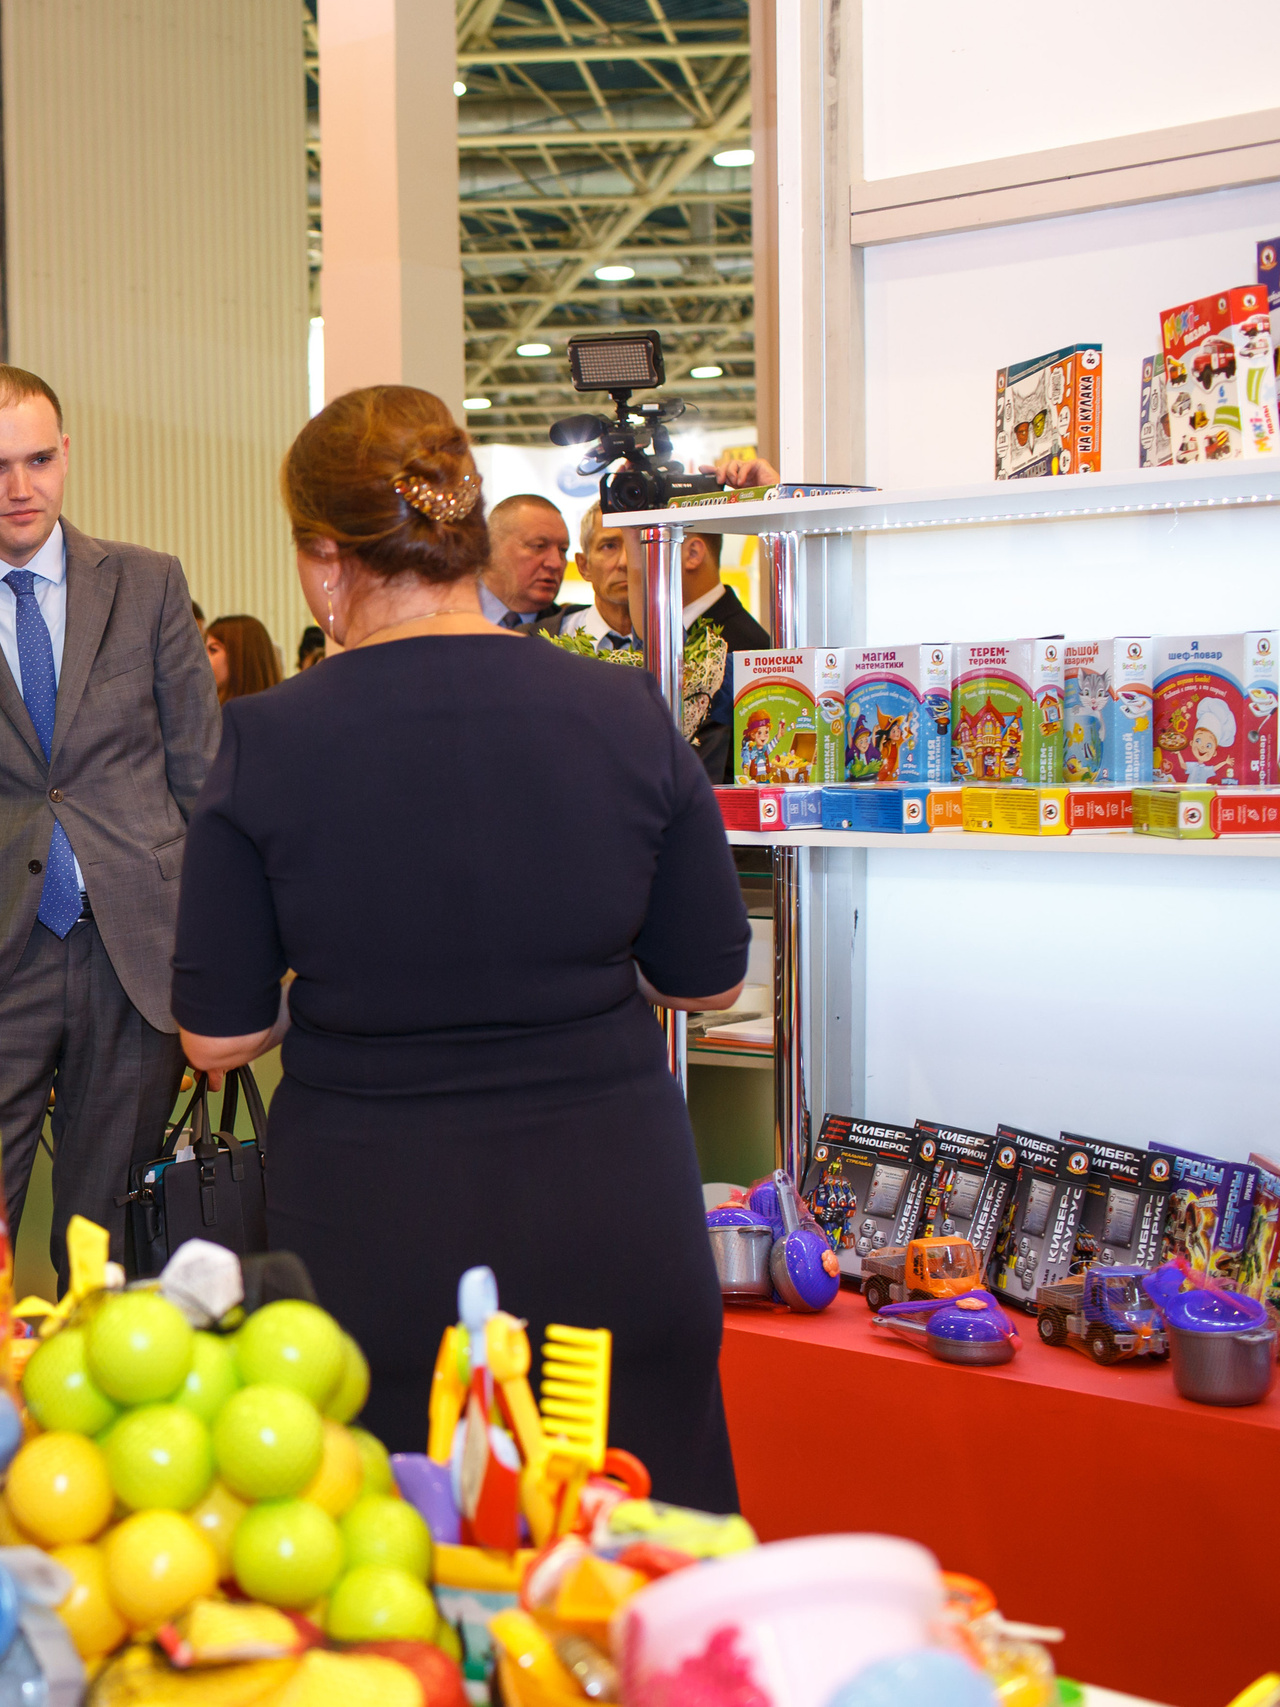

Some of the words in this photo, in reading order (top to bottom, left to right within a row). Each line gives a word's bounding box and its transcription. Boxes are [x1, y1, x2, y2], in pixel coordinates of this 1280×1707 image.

[1080, 374, 1093, 422] КУЛАКА
[1080, 436, 1093, 452] НА
[970, 647, 1010, 657] ТЕРЕМ-
[1064, 643, 1099, 656] ЛЬШОЙ
[1191, 641, 1199, 651] Я
[744, 657, 751, 667] В
[755, 655, 803, 666] ПОИСКАХ
[969, 657, 1007, 666] теремок
[1064, 657, 1094, 666] квариум
[1168, 651, 1223, 660] шеф-повар
[753, 666, 795, 675] сокровищ
[1122, 732, 1133, 785] ЛЬШОЙ
[1259, 735, 1267, 786] еф-повар
[851, 1123, 913, 1141] КИБЕР-
[938, 1129, 990, 1148] КИБЕР-
[849, 1134, 910, 1153] РИНОЦЕРОС
[940, 1142, 988, 1160] ЕНТУРИОН
[1016, 1135, 1059, 1154] КИБЕР-
[1020, 1149, 1057, 1167] АУРУС
[1092, 1157, 1139, 1176] ИГРИС
[1174, 1155, 1225, 1183] ЕРОНЫ
[895, 1172, 920, 1245] КИБЕР-
[971, 1180, 998, 1247] КИБЕР-
[1047, 1187, 1071, 1263] КИБЕР-
[1058, 1188, 1082, 1264] ТАУРУС
